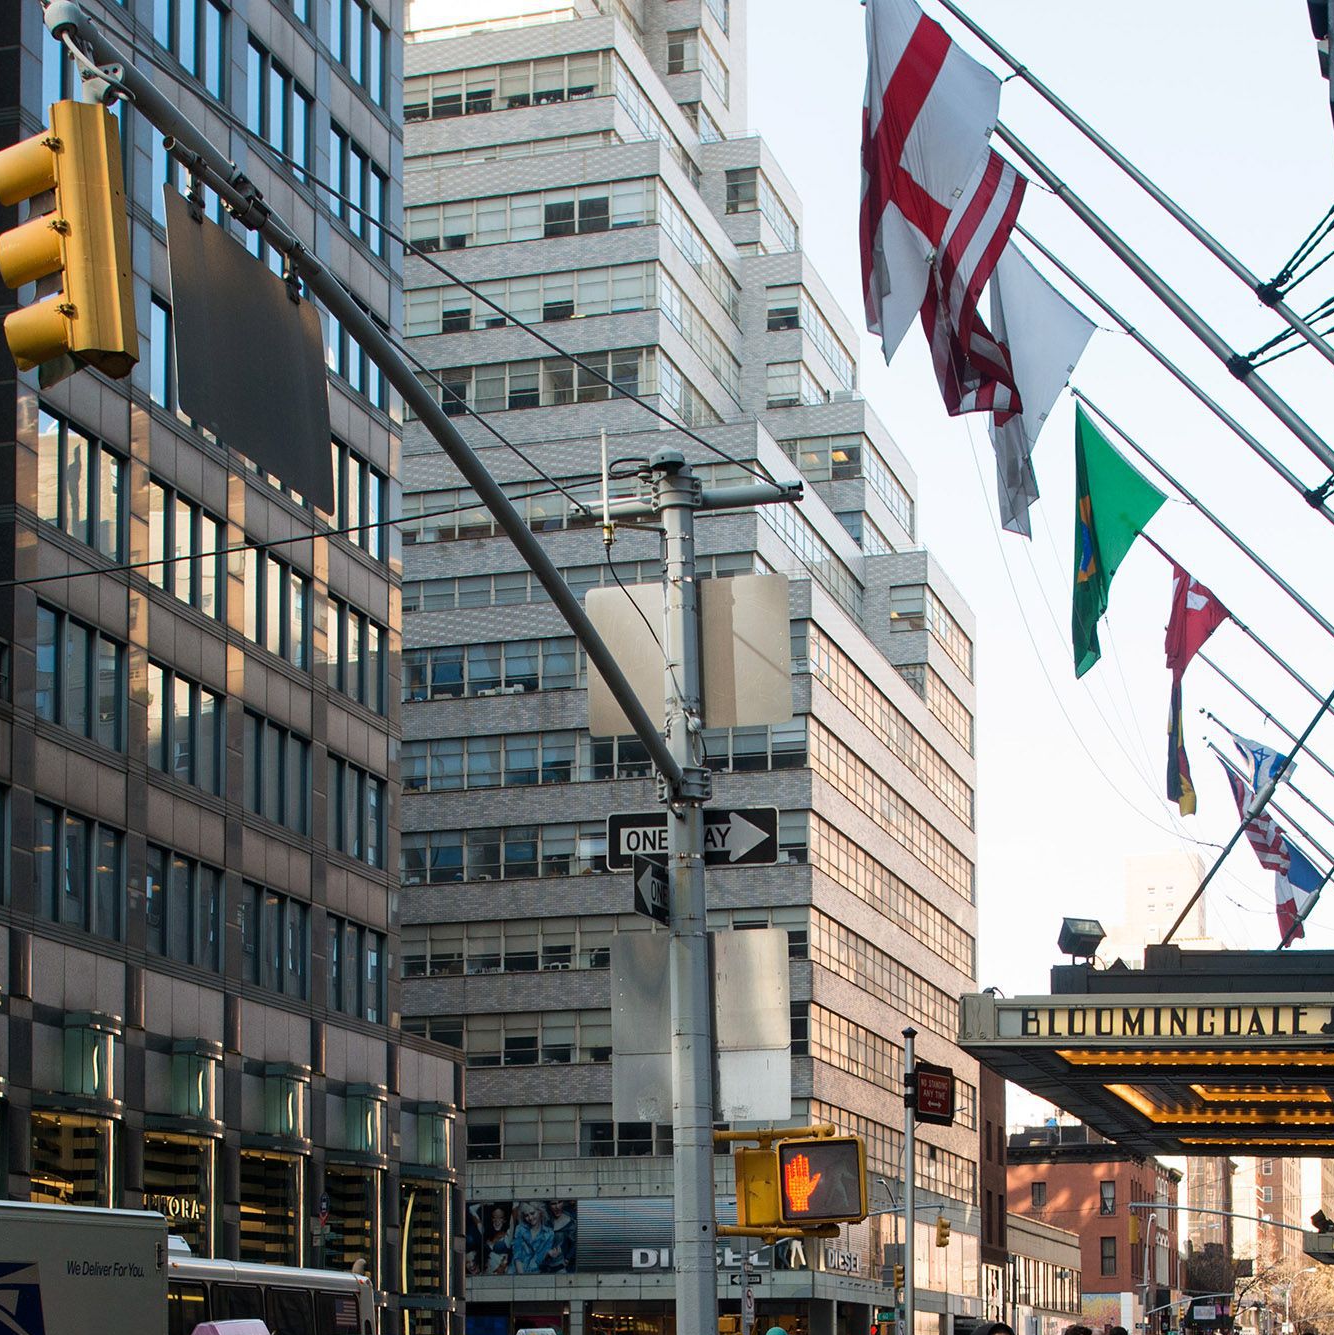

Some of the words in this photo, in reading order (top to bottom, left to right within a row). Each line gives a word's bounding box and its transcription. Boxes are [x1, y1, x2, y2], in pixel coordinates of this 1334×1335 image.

[626, 829, 668, 851] ONE
[703, 826, 731, 848] AY
[67, 1260, 82, 1276] We
[82, 1261, 113, 1276] Deliver
[113, 1262, 127, 1277] For
[632, 1247, 770, 1268] DIEL
[827, 1249, 860, 1273] DIESEL
